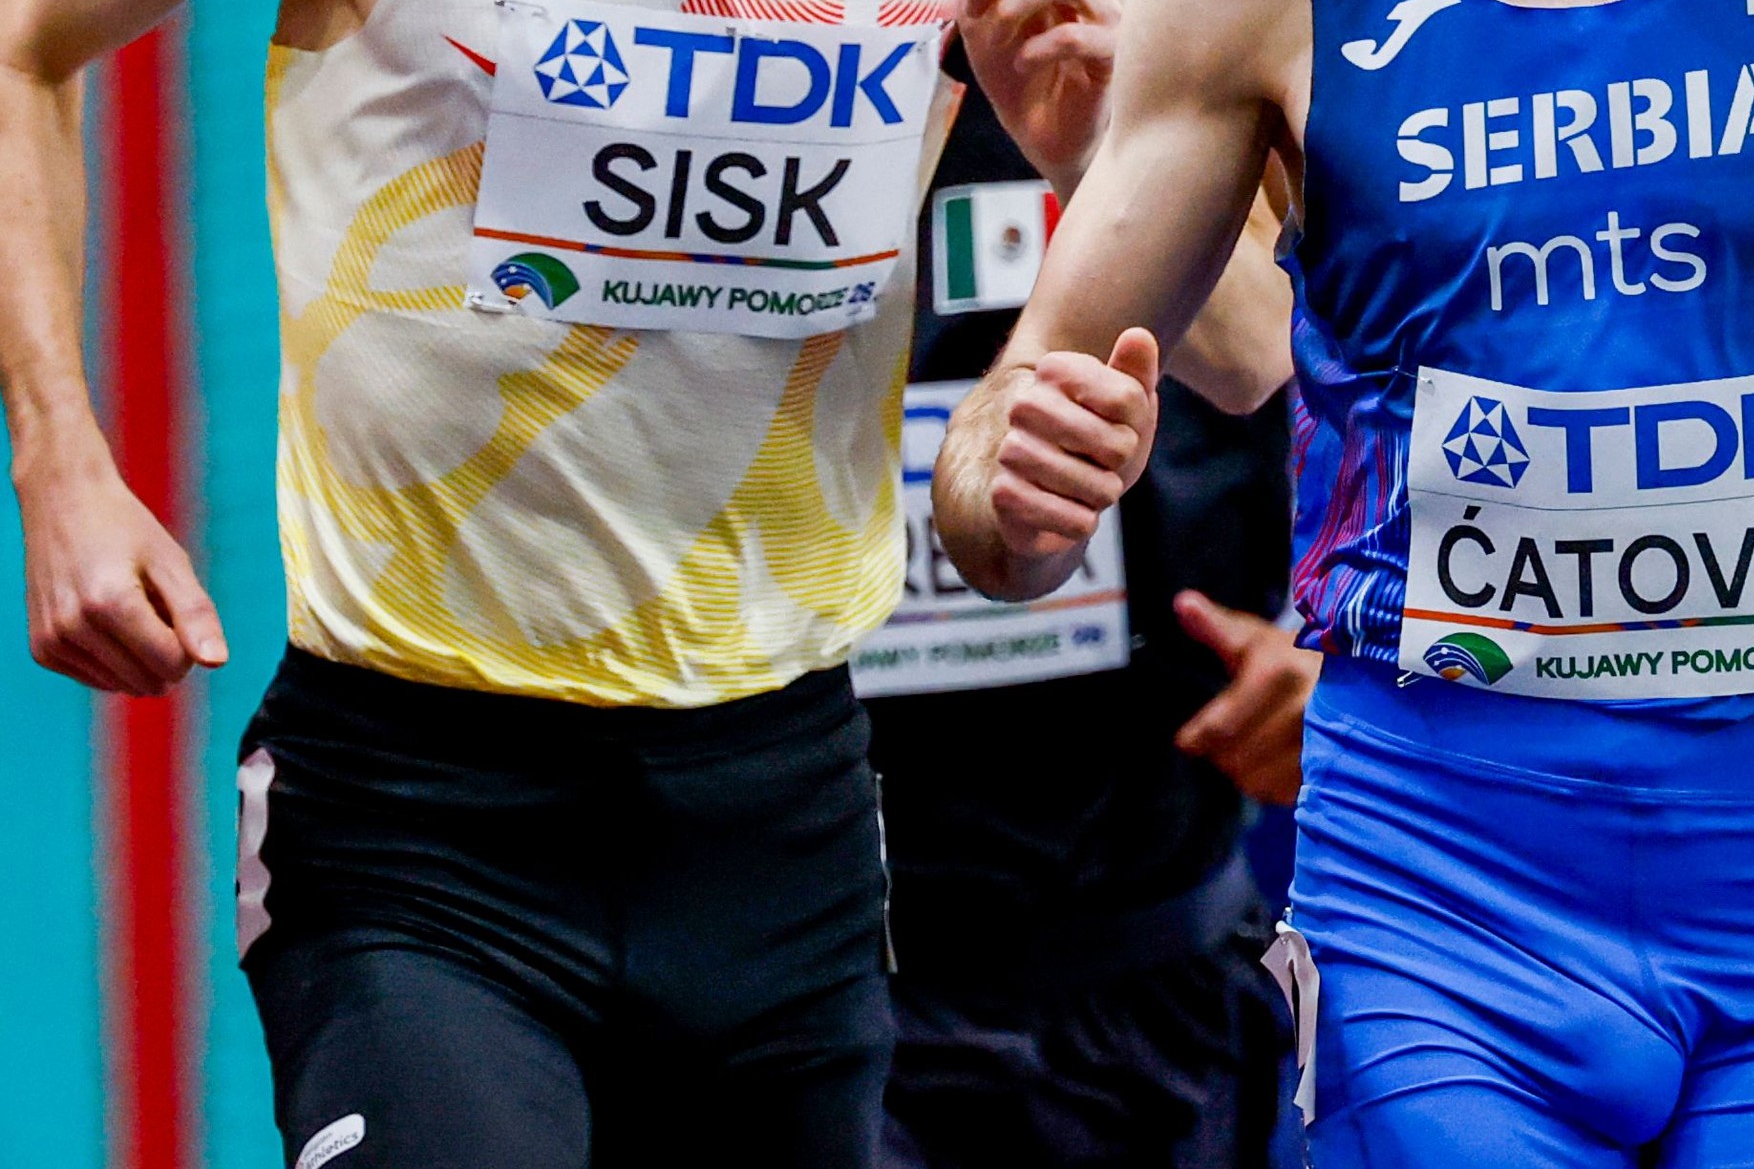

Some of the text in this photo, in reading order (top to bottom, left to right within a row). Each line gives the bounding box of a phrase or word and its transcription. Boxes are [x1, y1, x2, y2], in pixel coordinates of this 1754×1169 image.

[633, 25, 917, 128] TDK
[582, 142, 853, 248] SISK
[602, 279, 723, 308] KUJAWY
[1486, 210, 1707, 312] mts
[1536, 651, 1664, 680] KUJAWY
